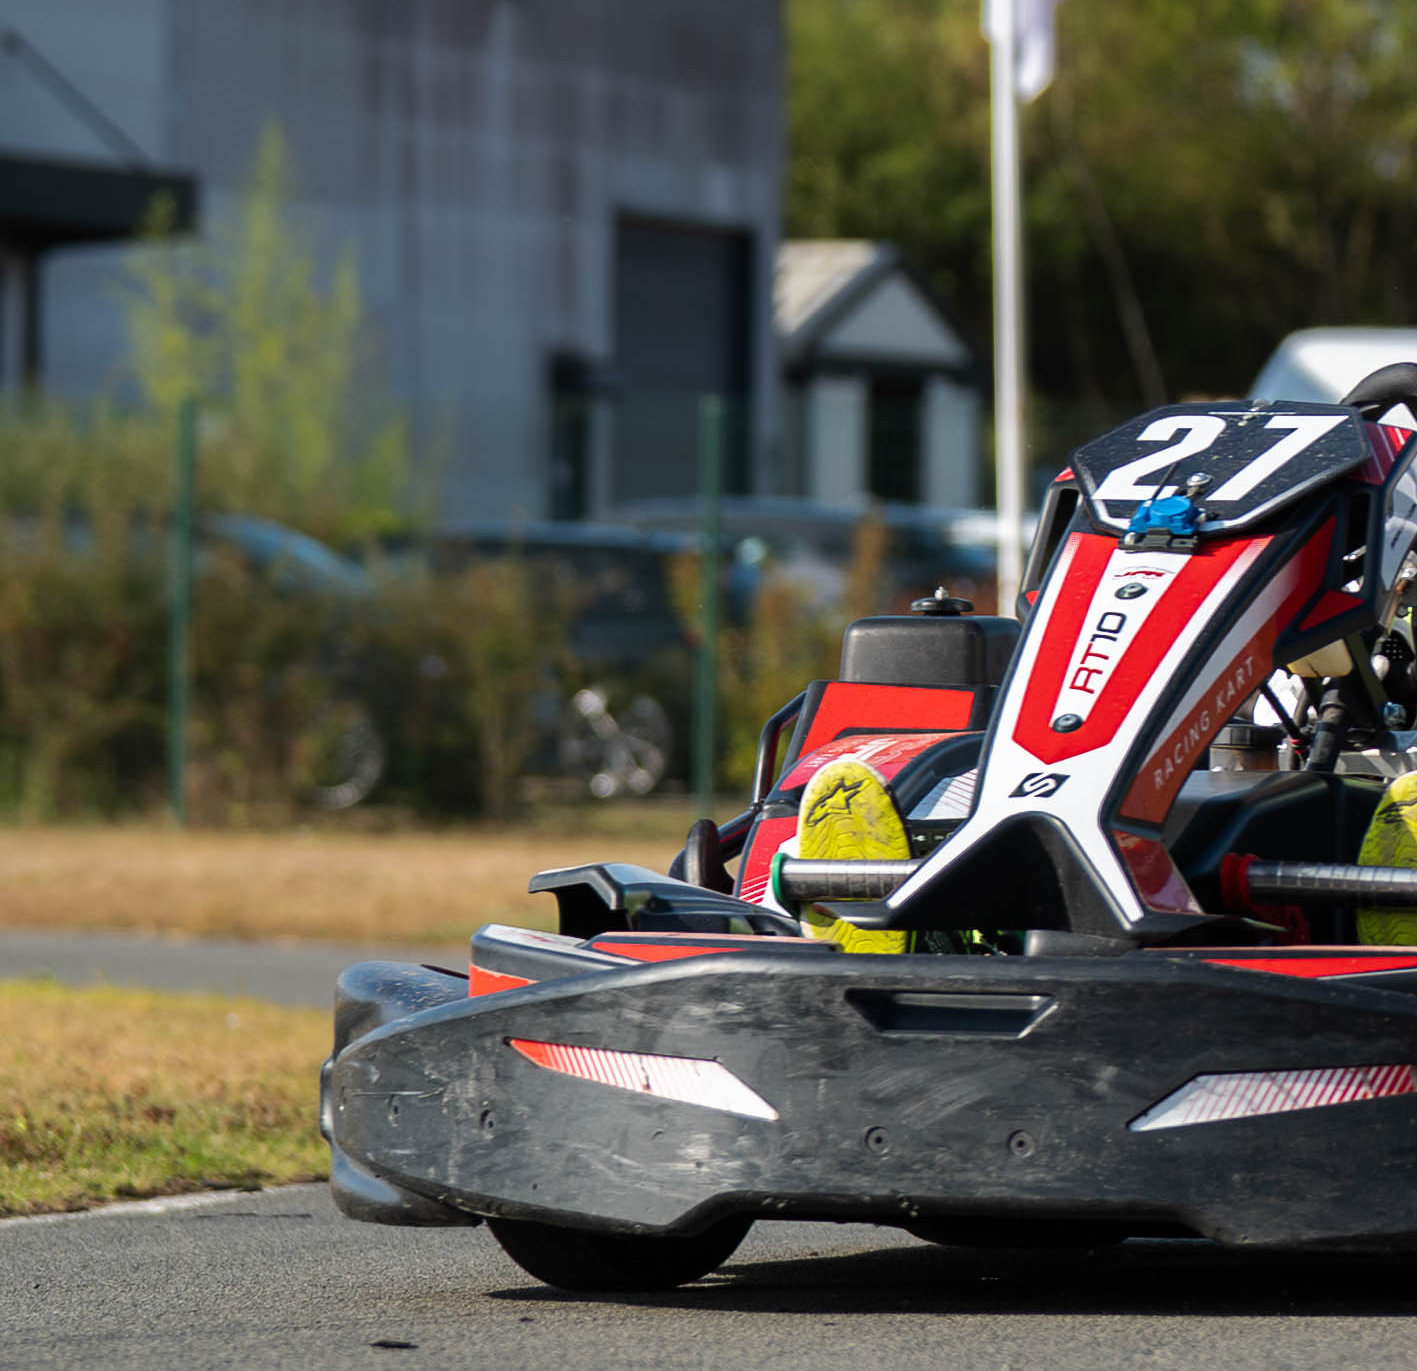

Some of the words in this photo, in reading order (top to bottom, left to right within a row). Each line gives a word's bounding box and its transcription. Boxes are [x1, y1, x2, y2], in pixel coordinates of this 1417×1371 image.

[1091, 415, 1350, 502] 27
[1069, 611, 1127, 694] RT10
[1154, 710, 1211, 790] RACING
[1216, 656, 1254, 713] KART
